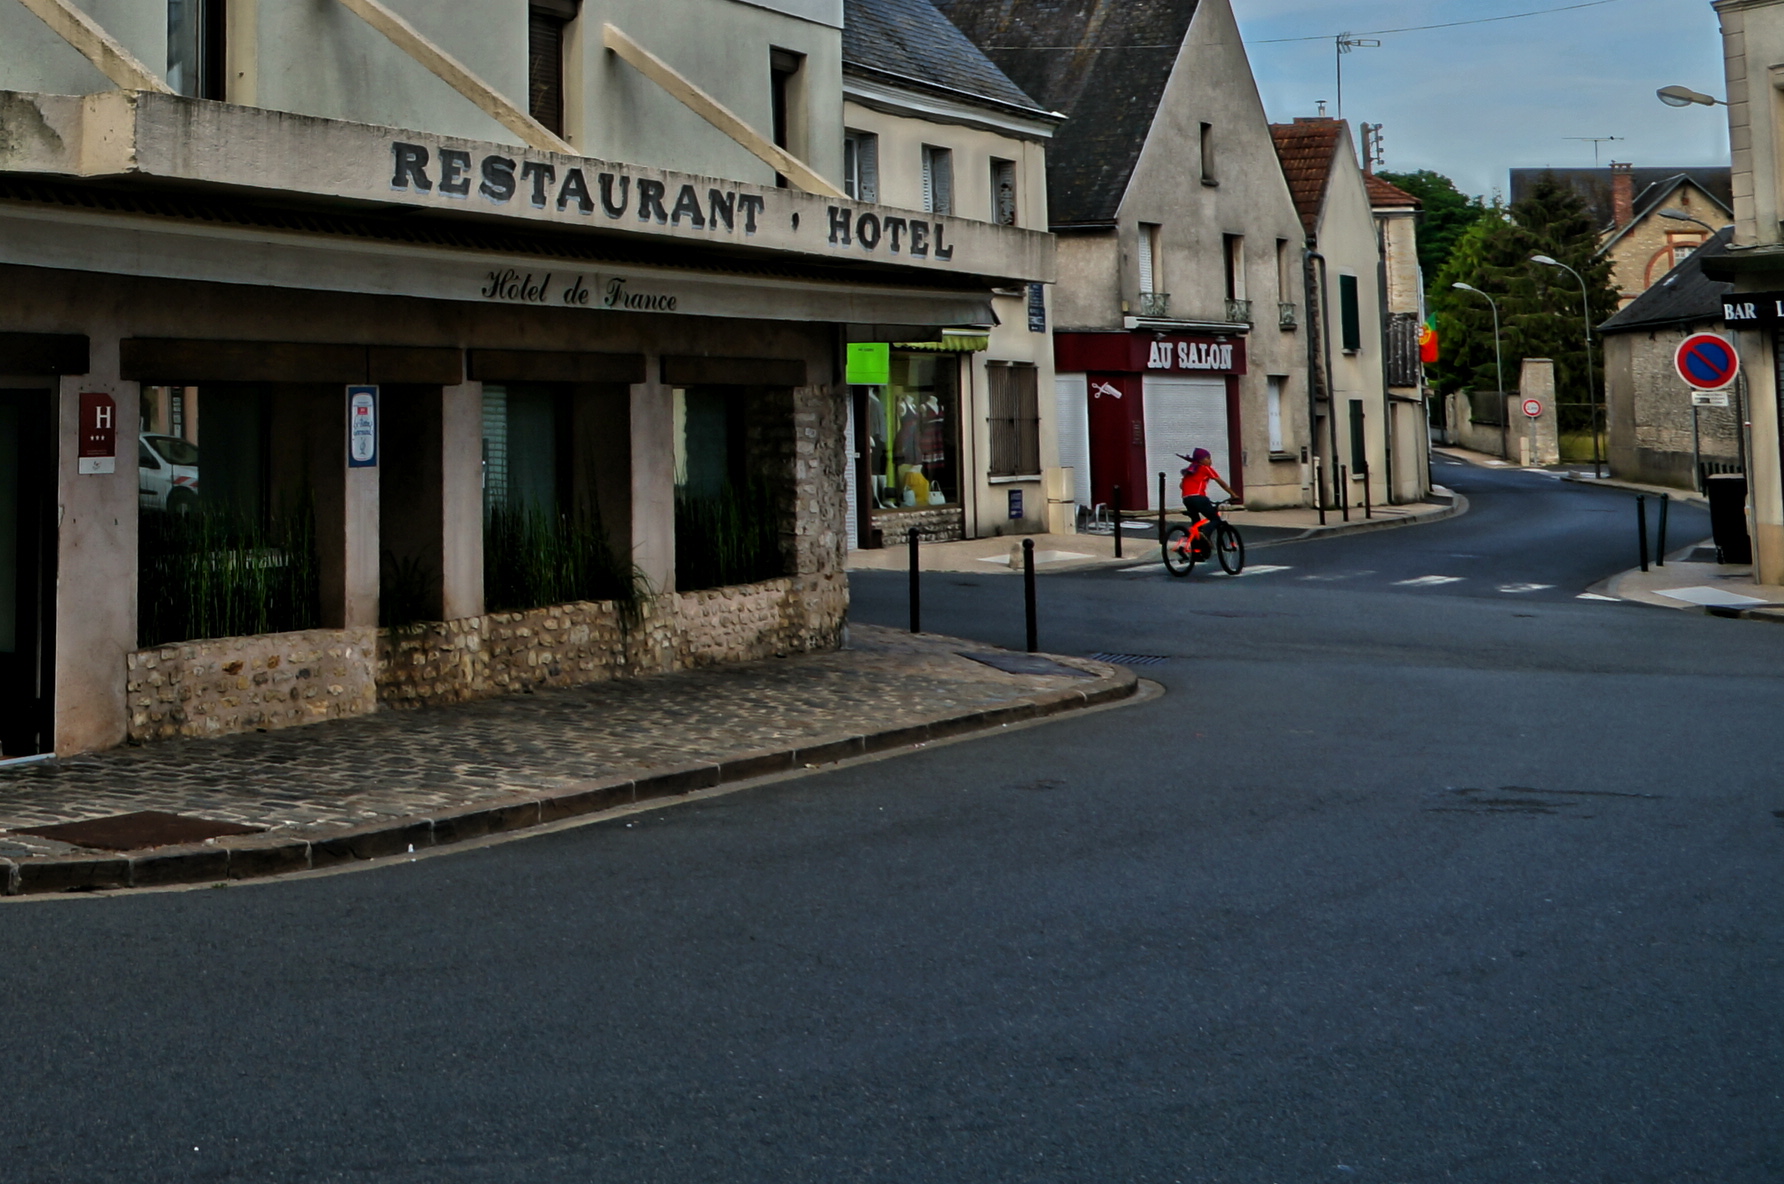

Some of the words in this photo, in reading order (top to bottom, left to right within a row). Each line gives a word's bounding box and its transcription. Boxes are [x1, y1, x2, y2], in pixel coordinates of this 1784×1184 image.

[390, 141, 765, 236] RESTAURANT
[827, 205, 954, 262] HOTEL
[562, 275, 589, 304] de
[604, 277, 677, 311] France
[1723, 302, 1757, 320] BAR
[1147, 341, 1173, 369] AU
[1177, 341, 1233, 369] SALON
[96, 406, 111, 429] H
